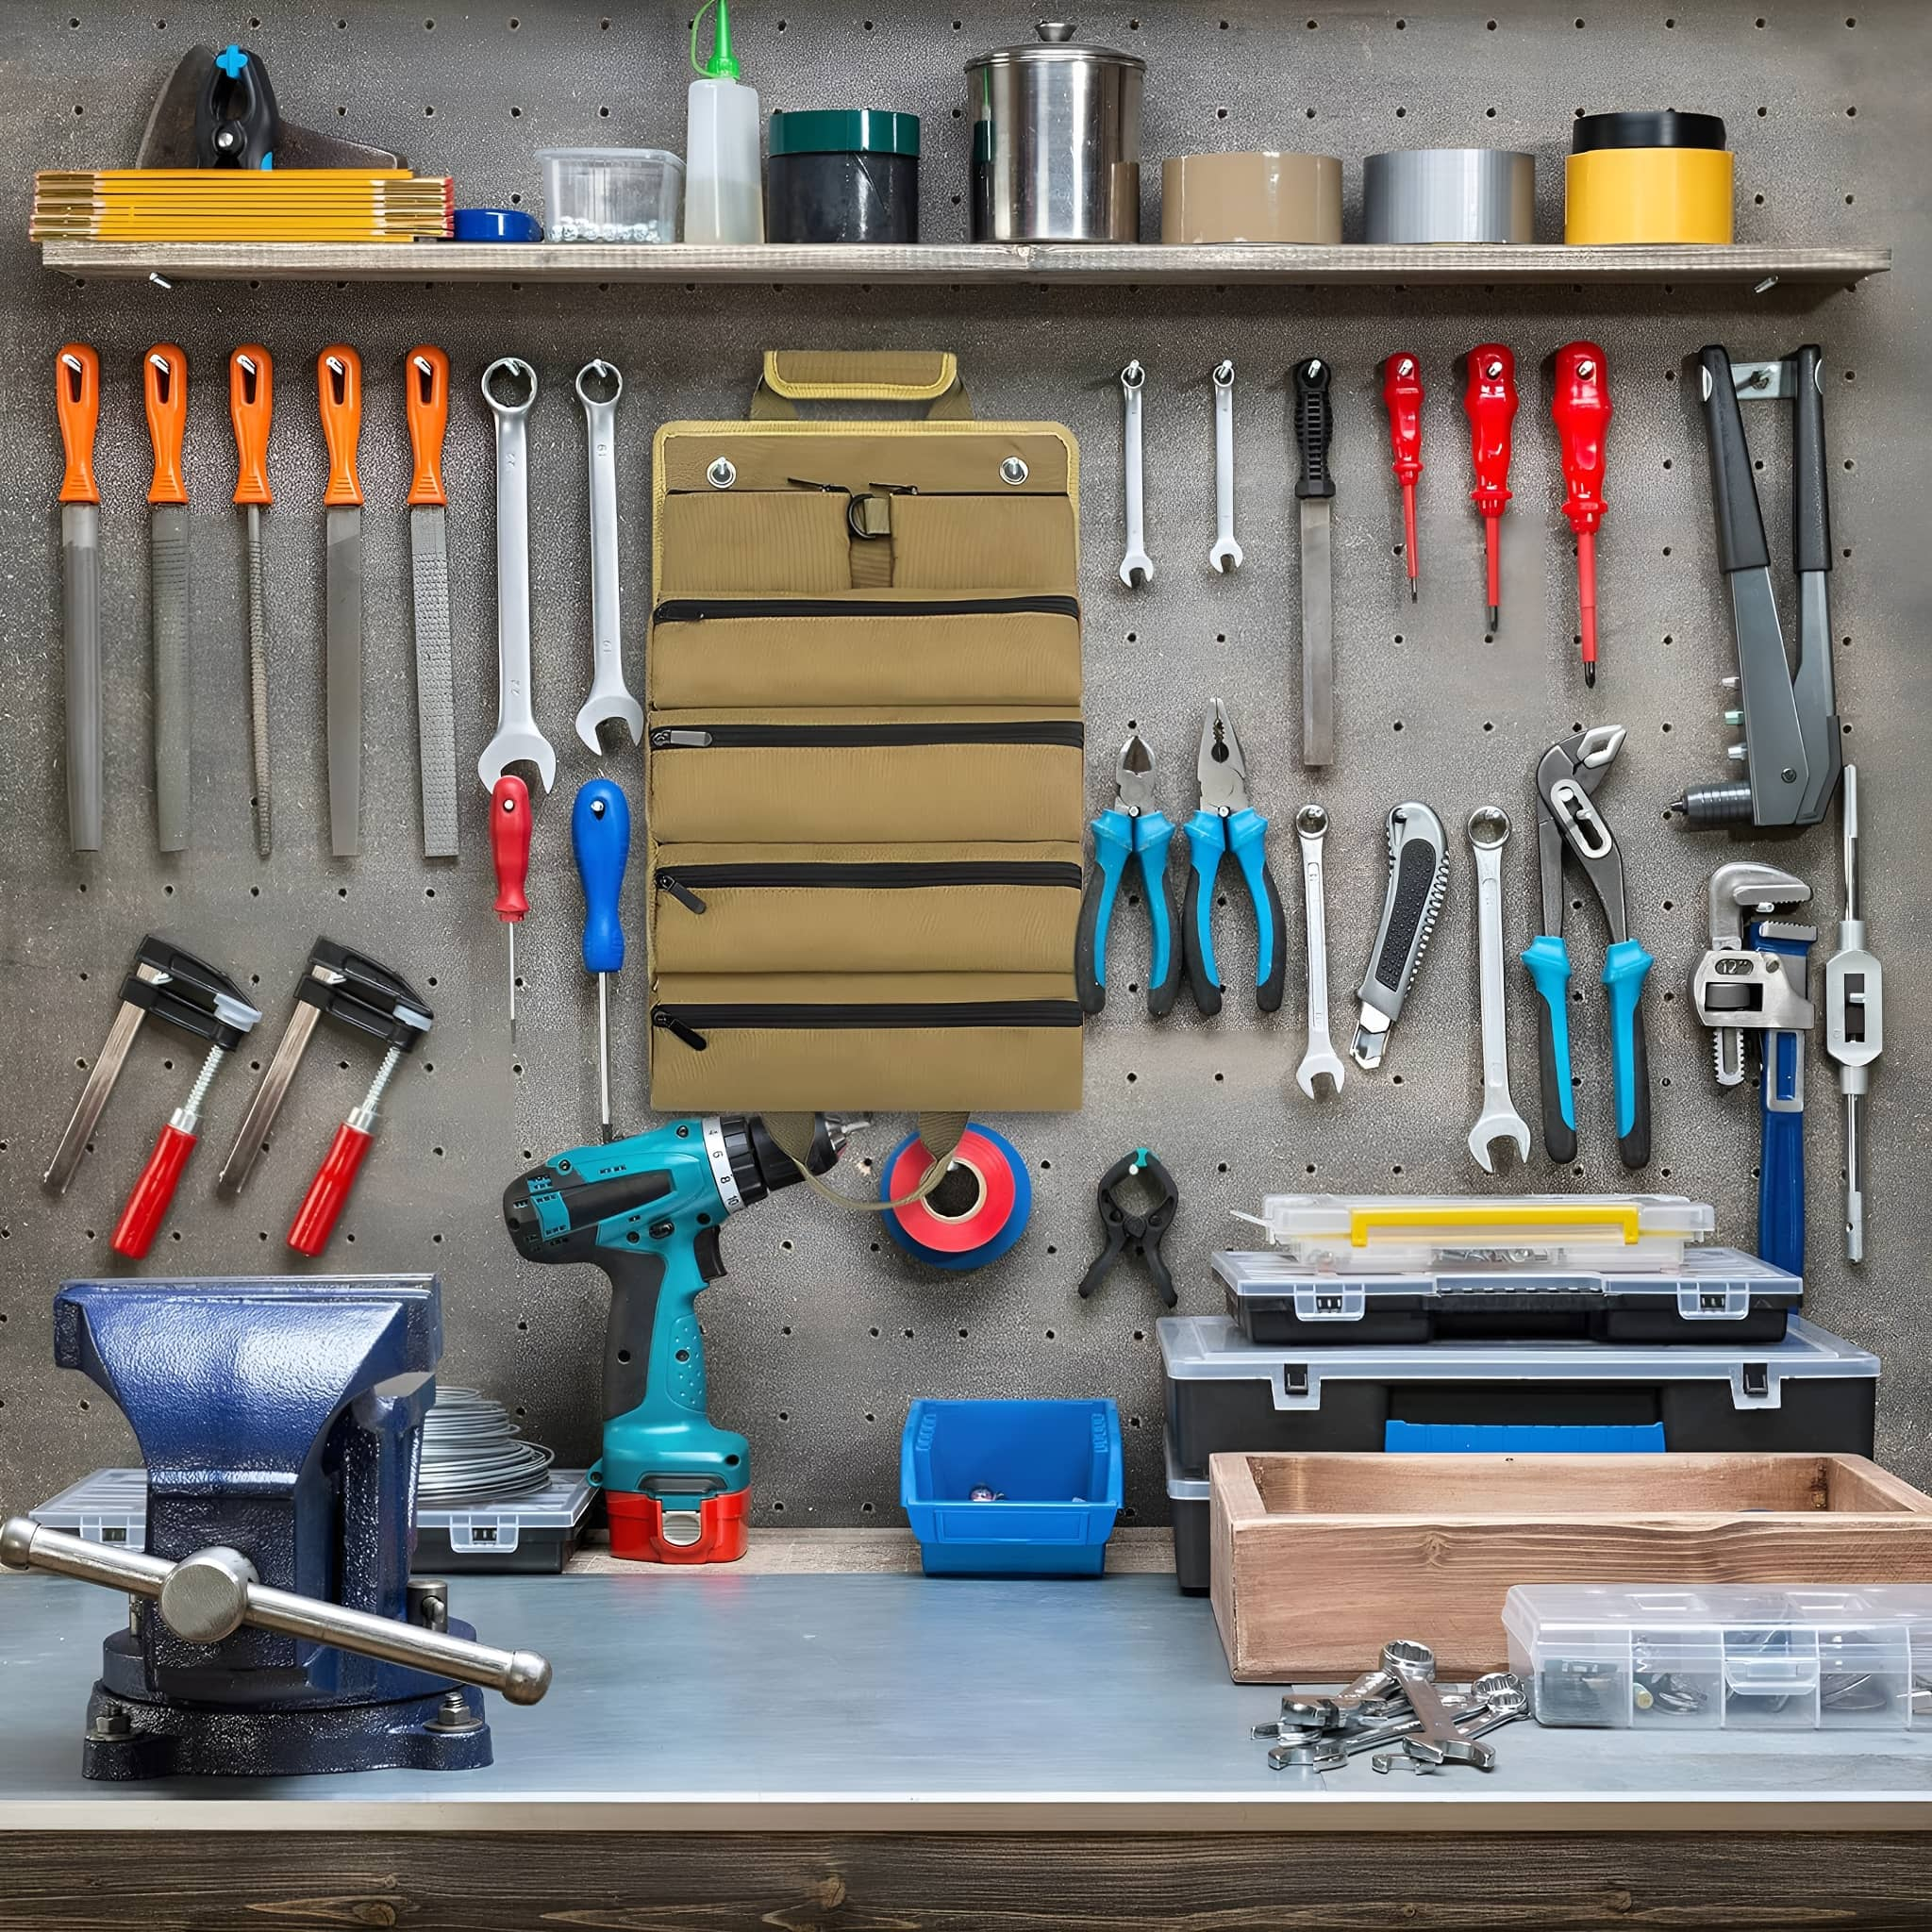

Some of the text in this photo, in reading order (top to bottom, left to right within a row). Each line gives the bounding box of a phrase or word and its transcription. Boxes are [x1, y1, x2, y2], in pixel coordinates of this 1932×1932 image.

[712, 1150, 724, 1158] 6
[720, 1175, 731, 1184] 8
[726, 1195, 740, 1206] 10
